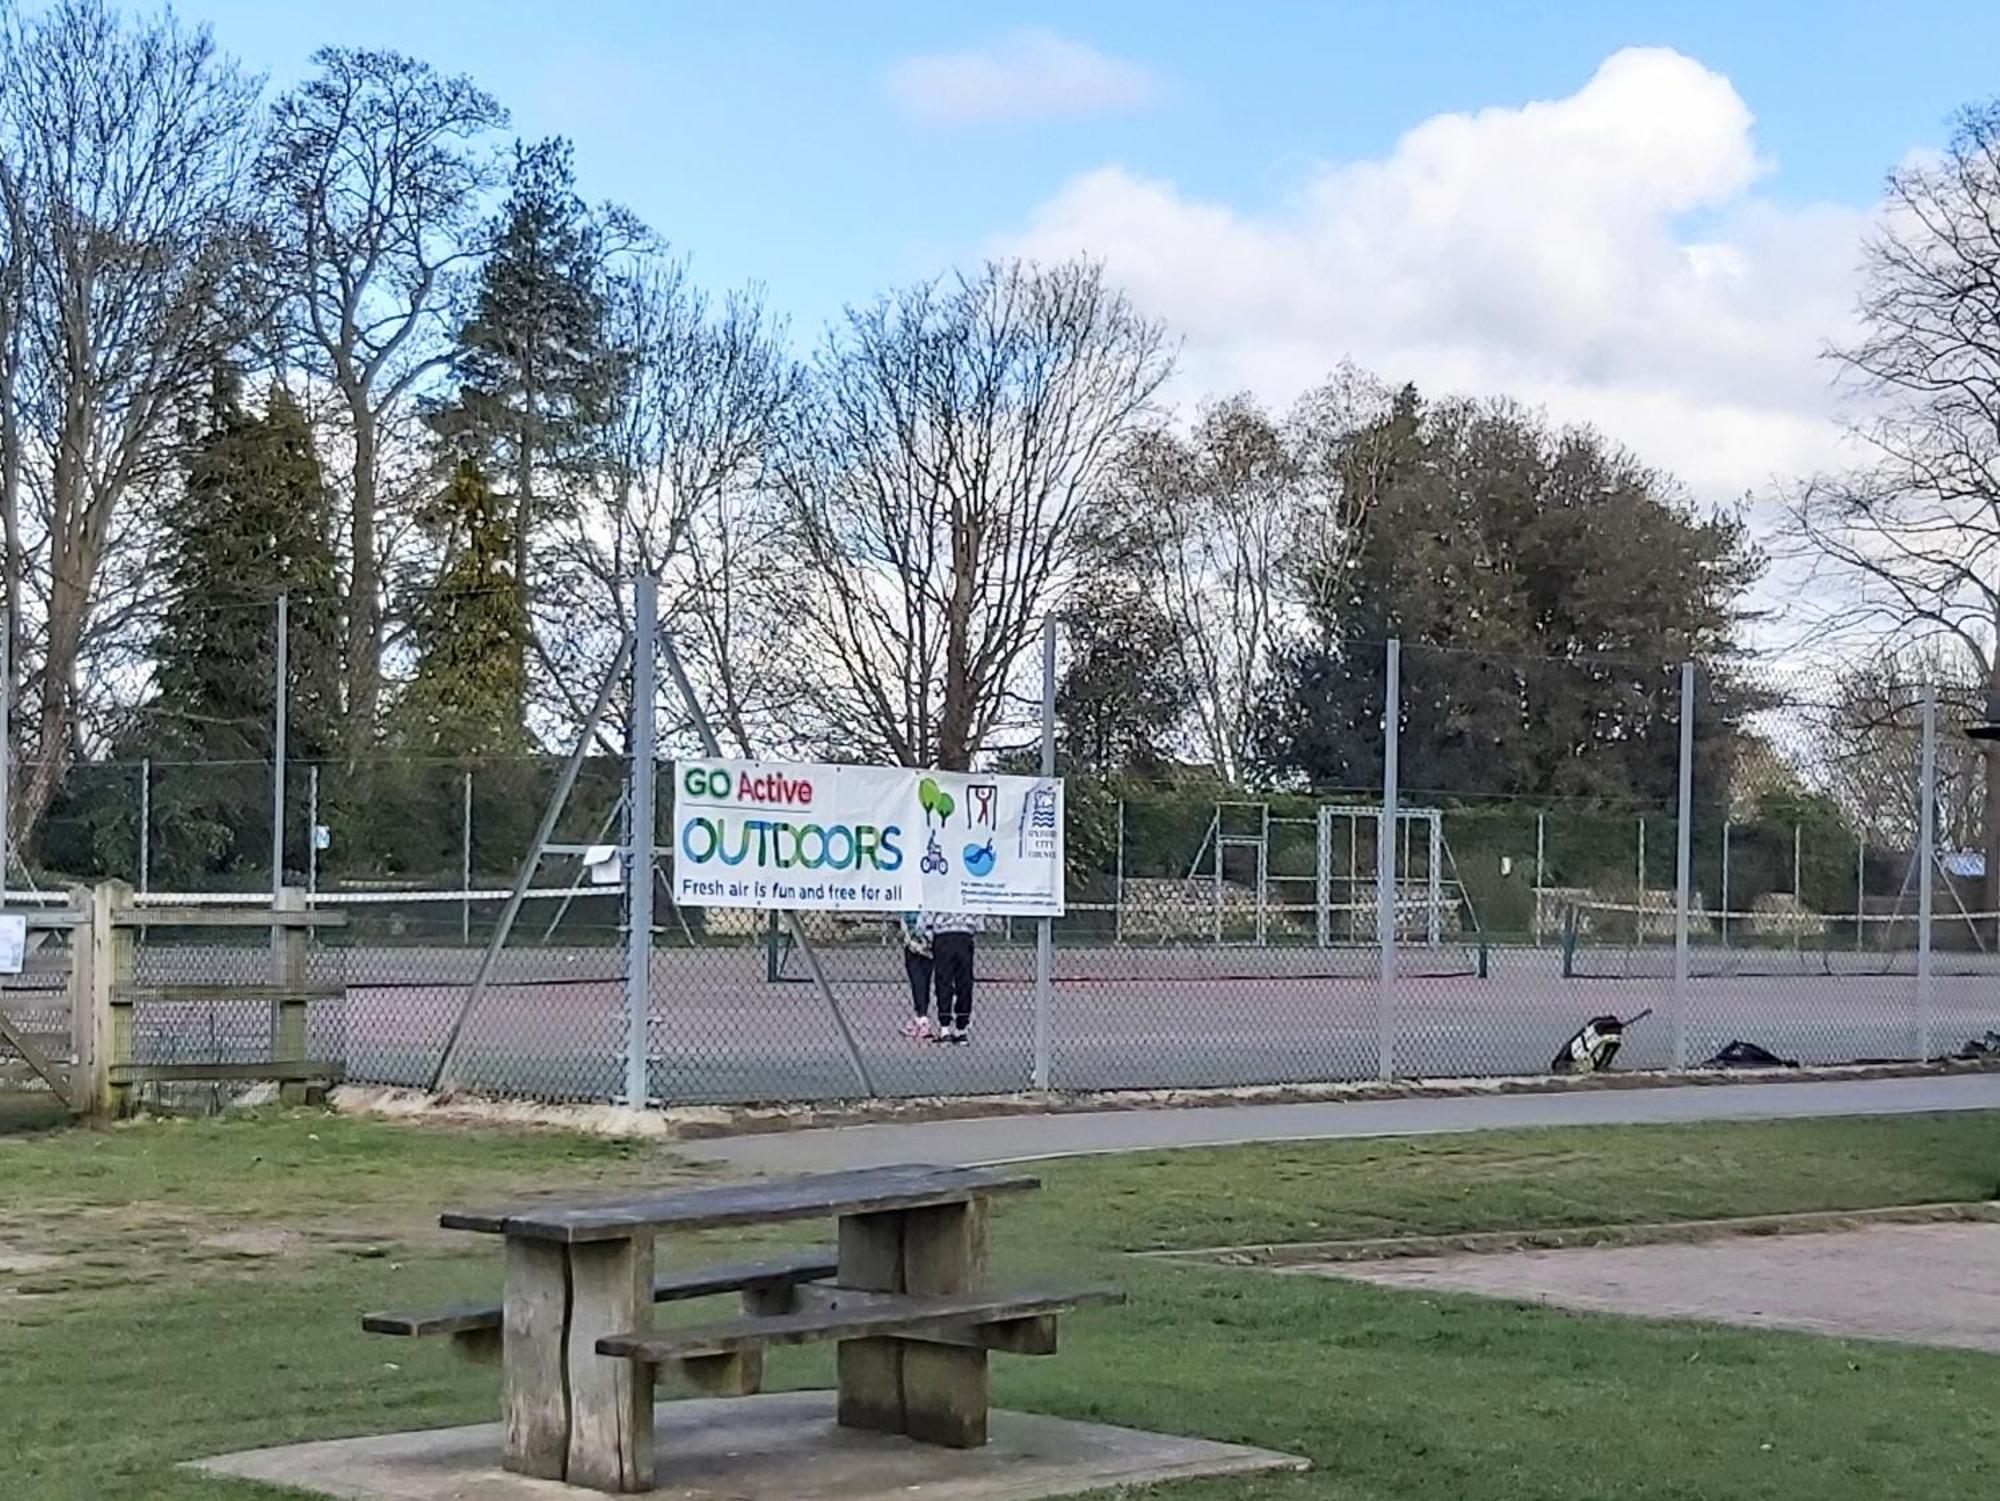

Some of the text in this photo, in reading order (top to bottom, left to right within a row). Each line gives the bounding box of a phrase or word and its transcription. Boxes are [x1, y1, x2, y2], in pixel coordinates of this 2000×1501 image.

[684, 768, 812, 804] GO Active
[682, 817, 903, 871] OUTDOORS
[682, 879, 902, 901] Fresh air is fun and free for all
